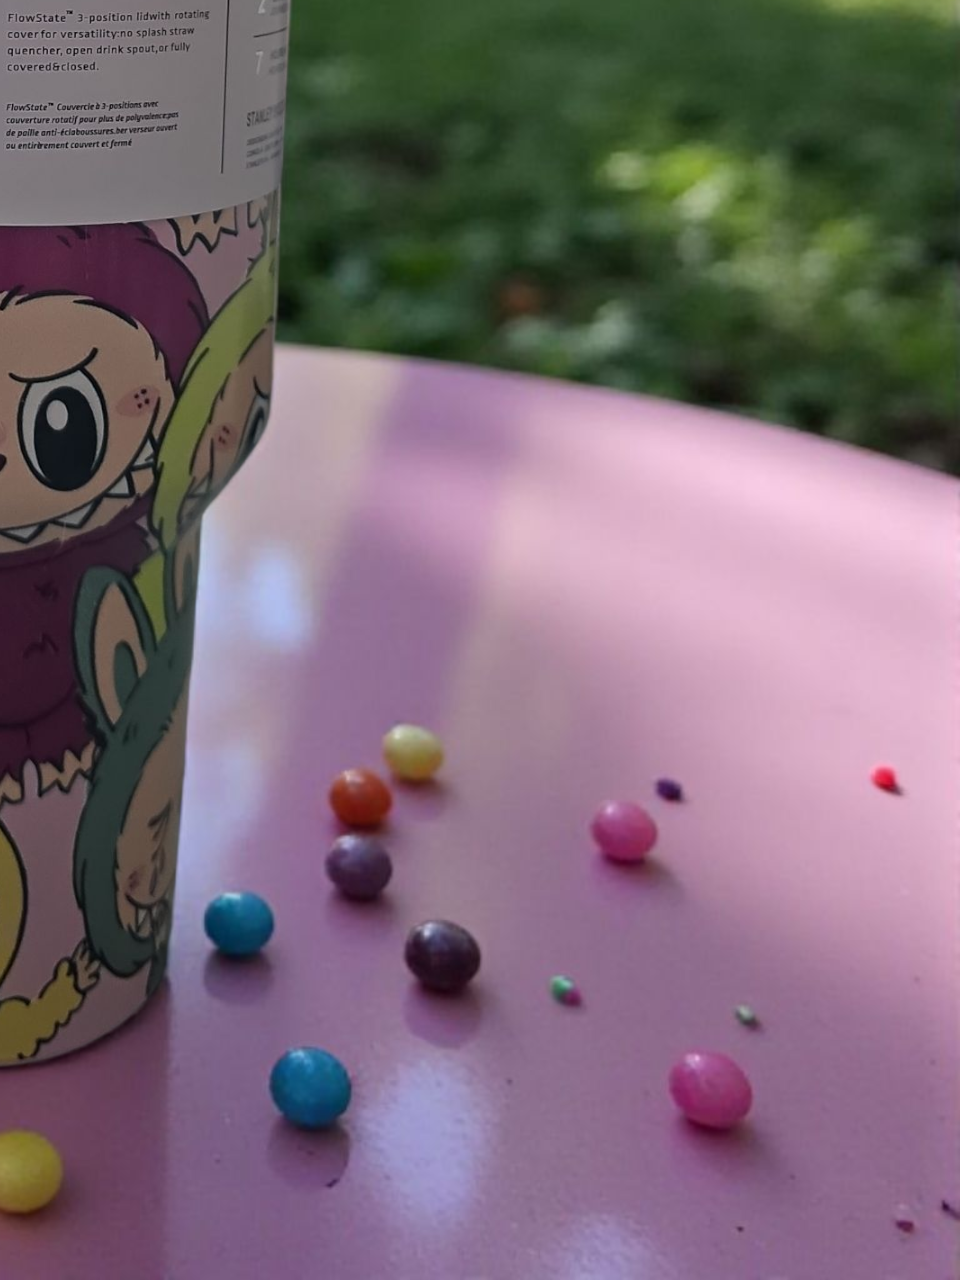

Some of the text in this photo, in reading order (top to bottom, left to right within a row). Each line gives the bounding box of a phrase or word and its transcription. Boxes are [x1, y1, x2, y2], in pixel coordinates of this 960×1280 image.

[78, 13, 133, 24] 3-position
[174, 10, 210, 20] rotating
[40, 30, 56, 38] for
[136, 28, 166, 38] splash
[170, 27, 195, 36] straw
[7, 46, 63, 56] quencher,
[66, 47, 92, 56] open
[96, 44, 124, 54] drink
[170, 42, 190, 52] fully
[101, 100, 142, 111] 3-positions
[143, 100, 158, 108] avec
[6, 116, 50, 124] couverture
[52, 114, 78, 125] rotatif
[78, 116, 98, 125] pour
[98, 114, 114, 124] plus
[115, 114, 124, 122] de
[6, 128, 16, 136] de
[17, 128, 39, 138] paille
[129, 126, 154, 134] verseur
[156, 123, 178, 132] ouvert
[70, 140, 99, 149] couvert
[101, 140, 109, 148] et
[109, 138, 132, 150] fermé
